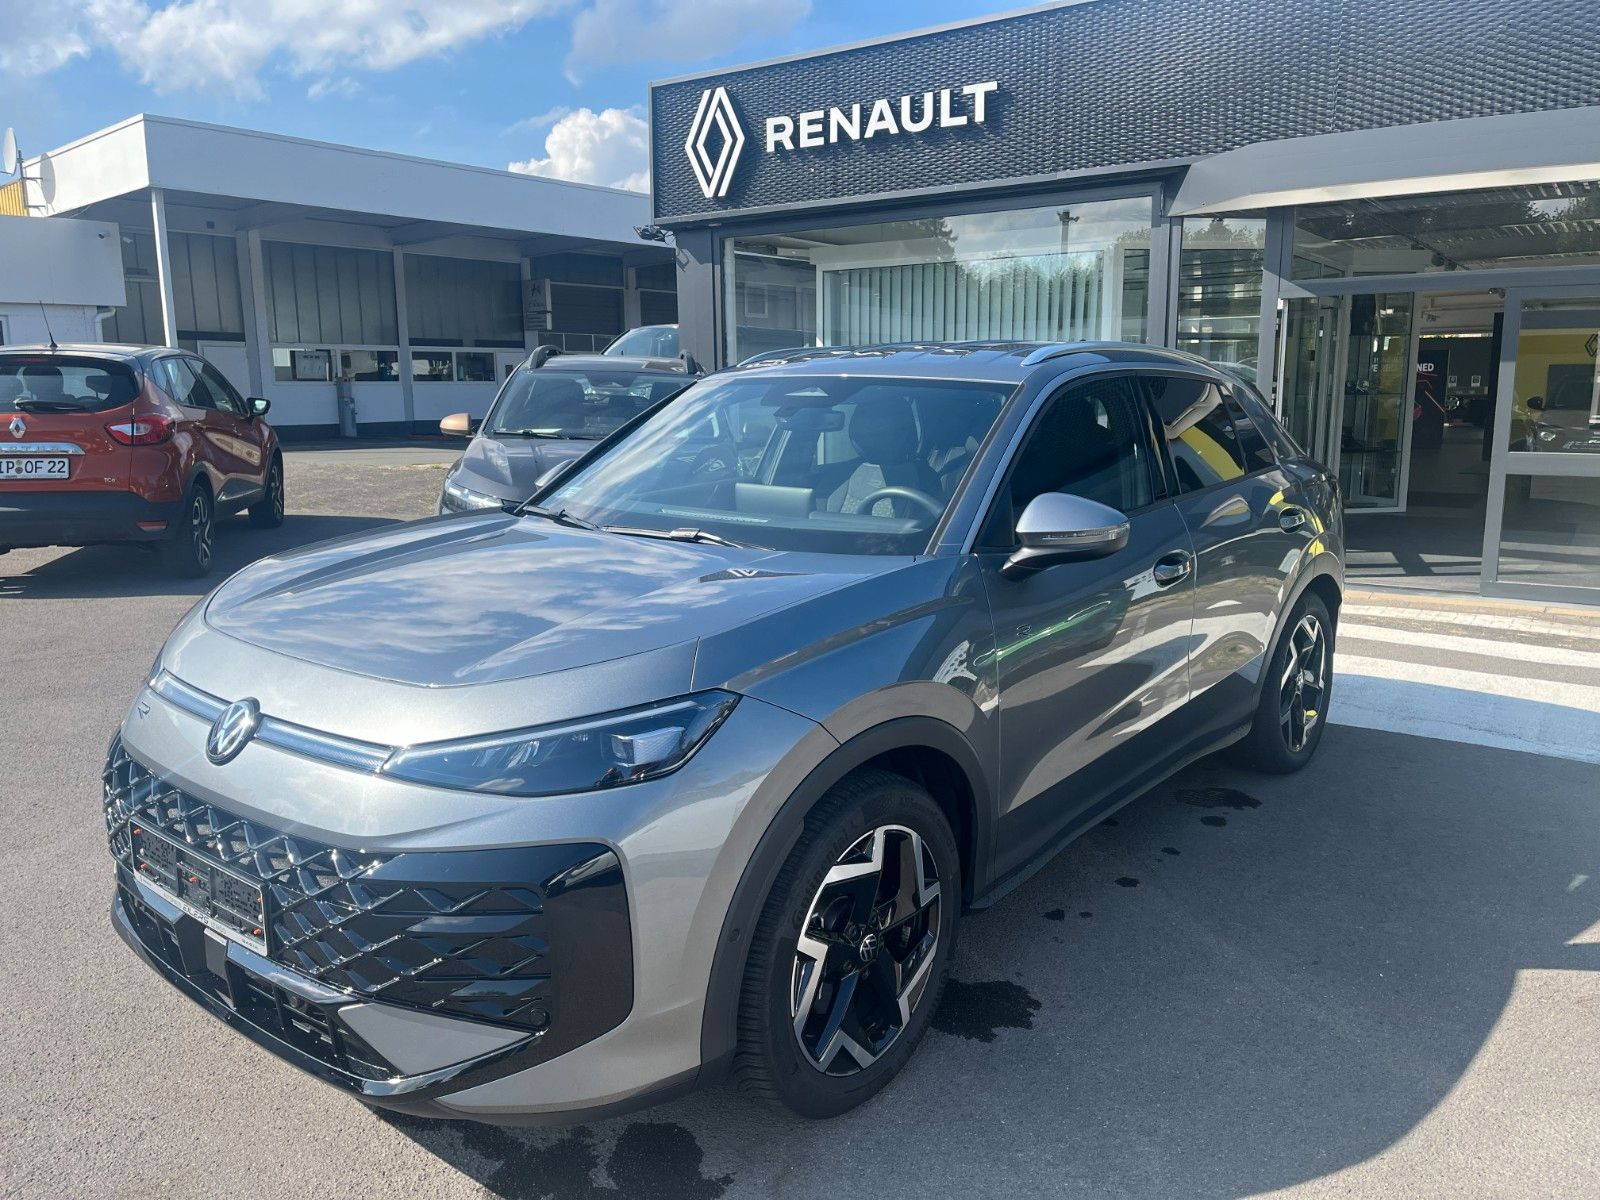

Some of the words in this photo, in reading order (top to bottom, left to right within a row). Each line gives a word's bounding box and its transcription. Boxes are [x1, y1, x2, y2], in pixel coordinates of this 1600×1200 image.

[765, 80, 998, 153] RENAULT
[25, 460, 44, 474] OF
[47, 460, 66, 474] 22
